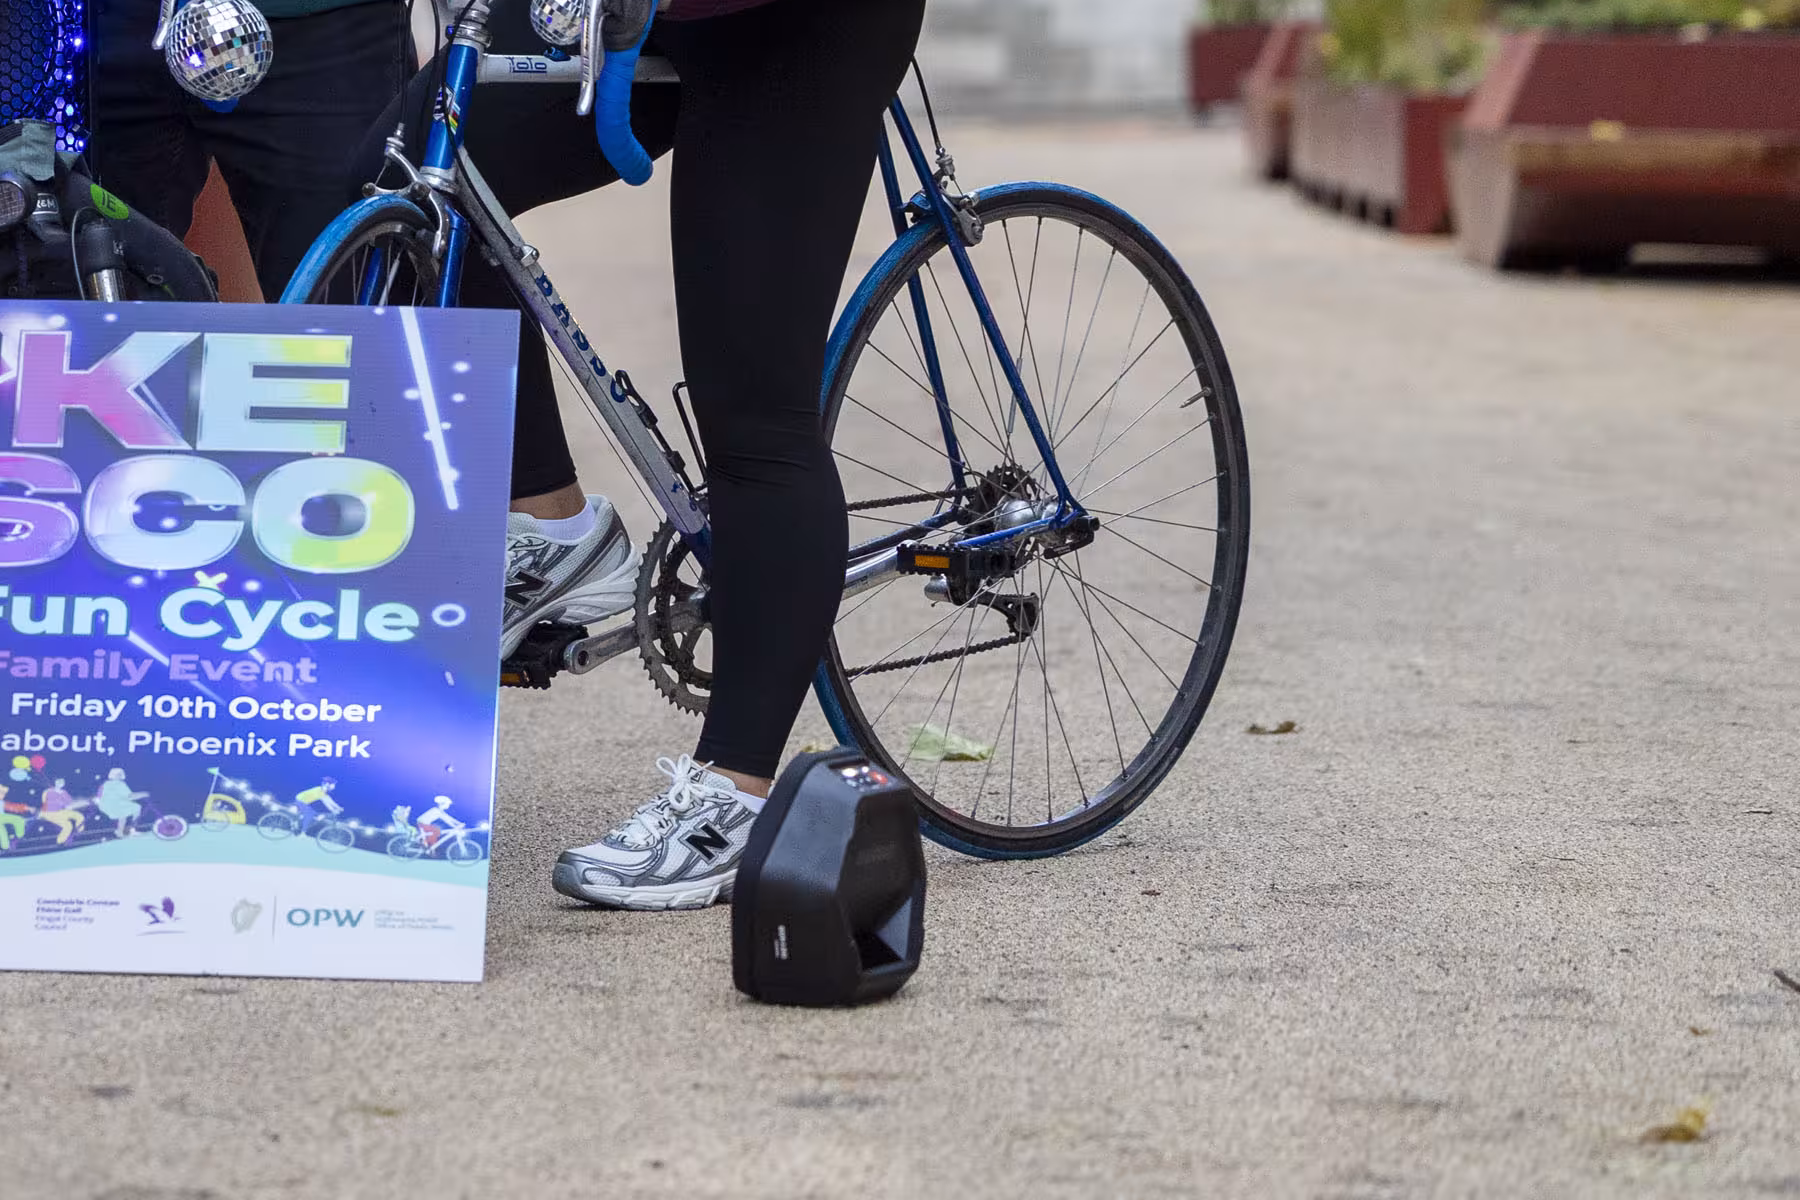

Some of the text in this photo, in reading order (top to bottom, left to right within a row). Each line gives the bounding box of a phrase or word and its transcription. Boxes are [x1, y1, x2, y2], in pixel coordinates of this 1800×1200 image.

[160, 587, 420, 652] Cycle
[168, 653, 318, 685] Event
[11, 692, 127, 722] Friday
[137, 694, 217, 719] 10th
[228, 696, 382, 723] October
[128, 730, 277, 756] Phoenix
[288, 733, 371, 759] Park
[287, 908, 365, 928] OPW
